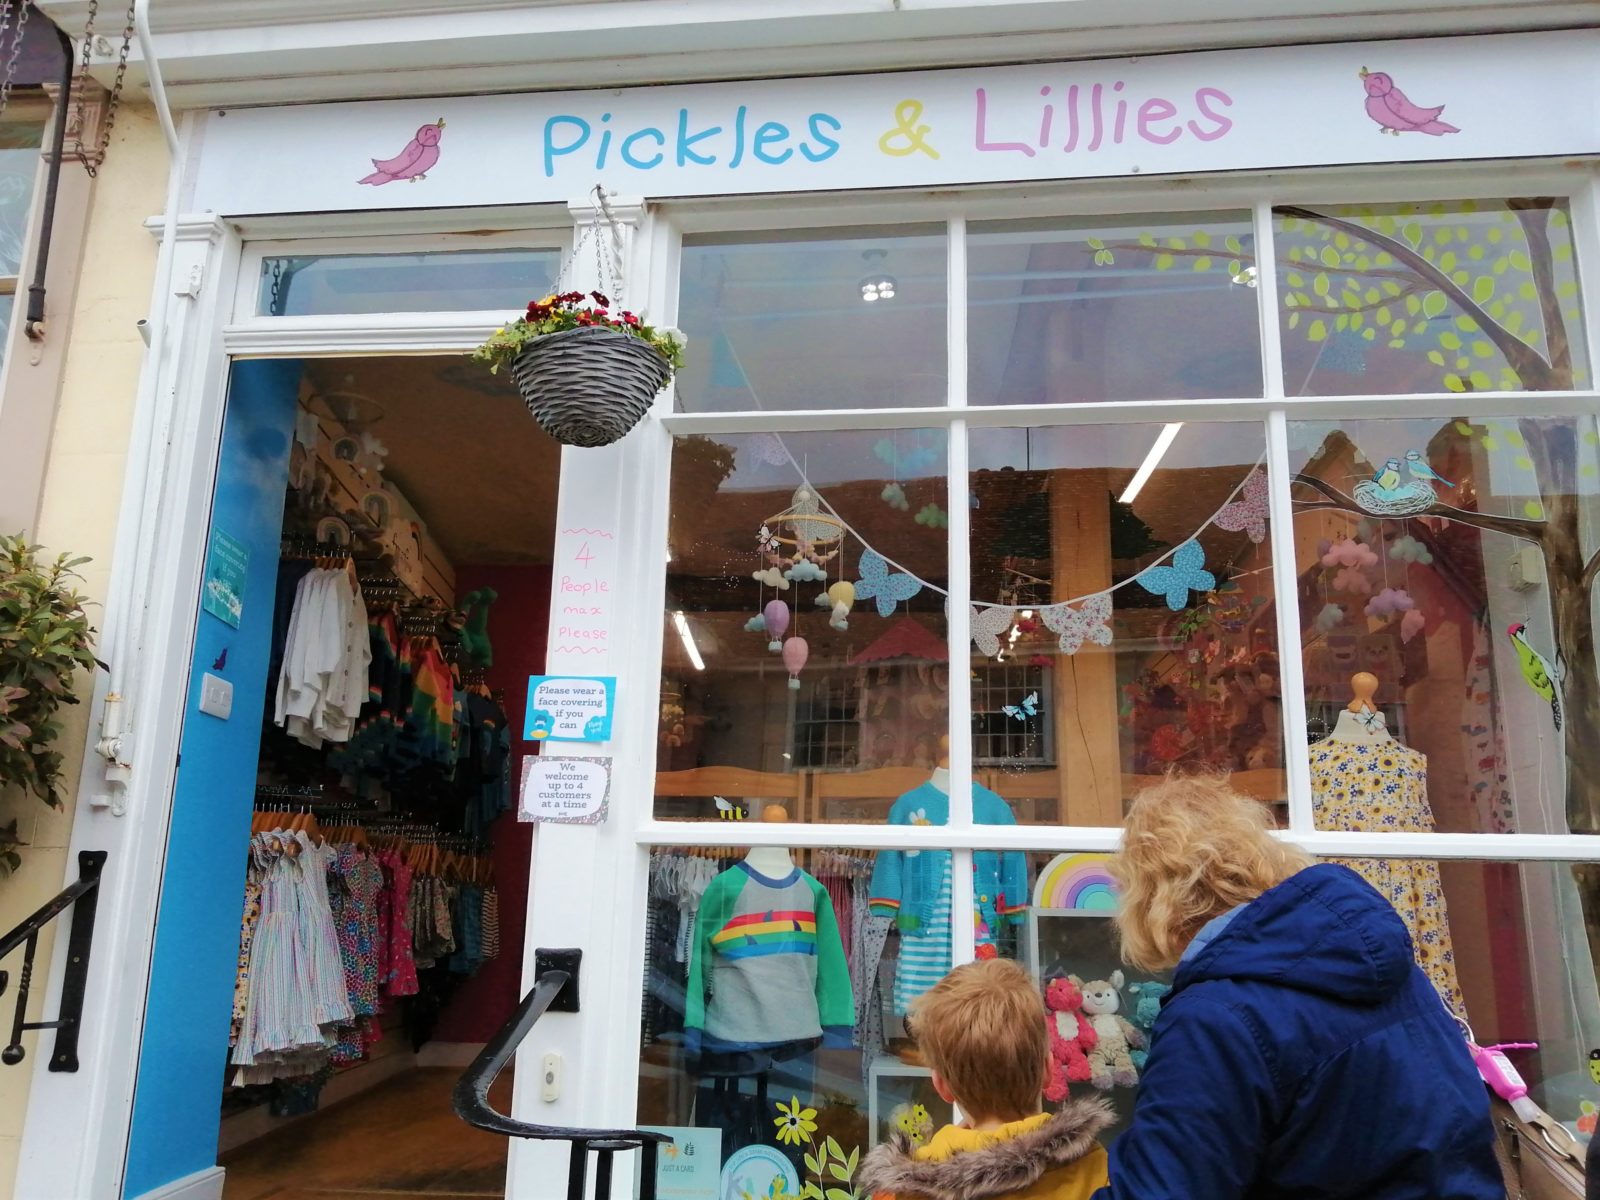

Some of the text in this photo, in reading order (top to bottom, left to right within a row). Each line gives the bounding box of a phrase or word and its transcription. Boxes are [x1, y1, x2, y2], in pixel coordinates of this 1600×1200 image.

[543, 80, 1233, 177] Pickles & Lillies
[575, 541, 596, 569] 4
[560, 575, 609, 597] People
[563, 606, 603, 616] max
[559, 626, 608, 640] Please
[539, 685, 570, 695] Please
[572, 687, 597, 695] wear
[538, 697, 603, 709] face covering
[555, 708, 584, 719] if you
[559, 763, 576, 772] We
[545, 772, 589, 781] welcome
[548, 782, 561, 792] up
[576, 782, 584, 790] 4
[538, 791, 592, 800] customers
[563, 800, 588, 809] time
